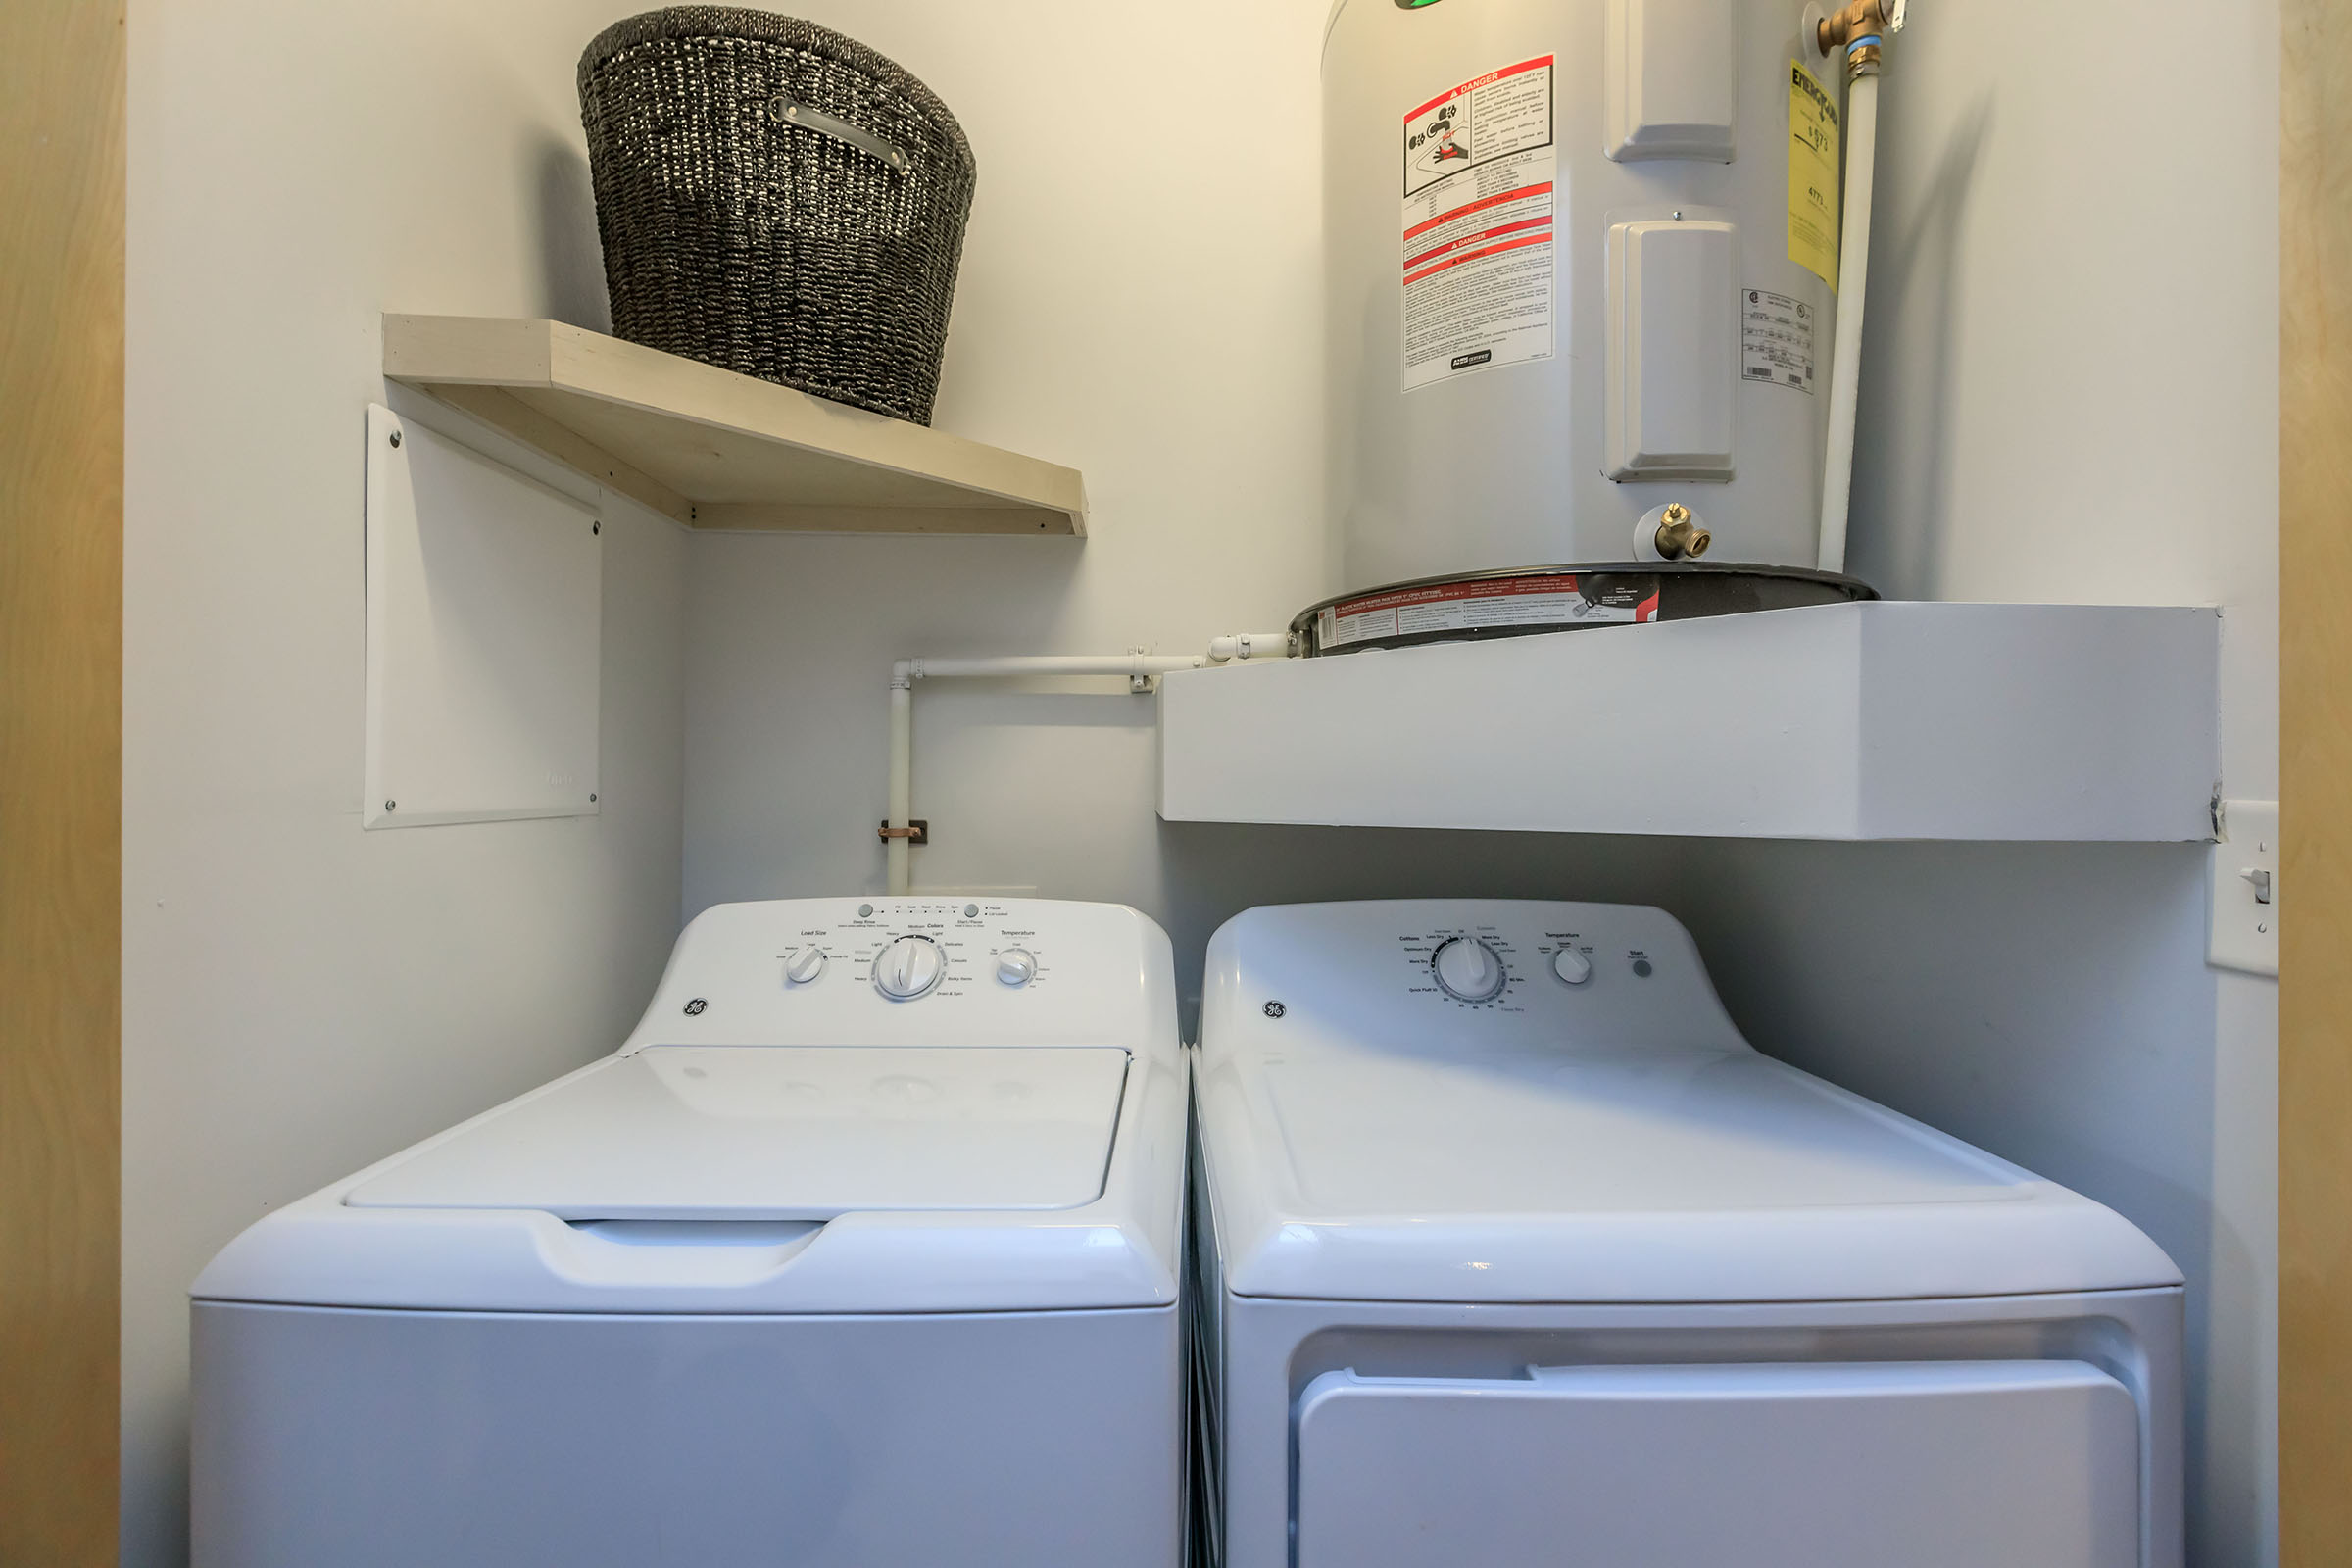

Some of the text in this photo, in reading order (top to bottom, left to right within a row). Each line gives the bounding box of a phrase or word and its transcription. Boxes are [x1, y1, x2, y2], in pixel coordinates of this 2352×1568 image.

[1460, 73, 1498, 94] DANGER
[1473, 194, 1513, 210] ADVERTENCIA
[1458, 233, 1486, 246] DANGER
